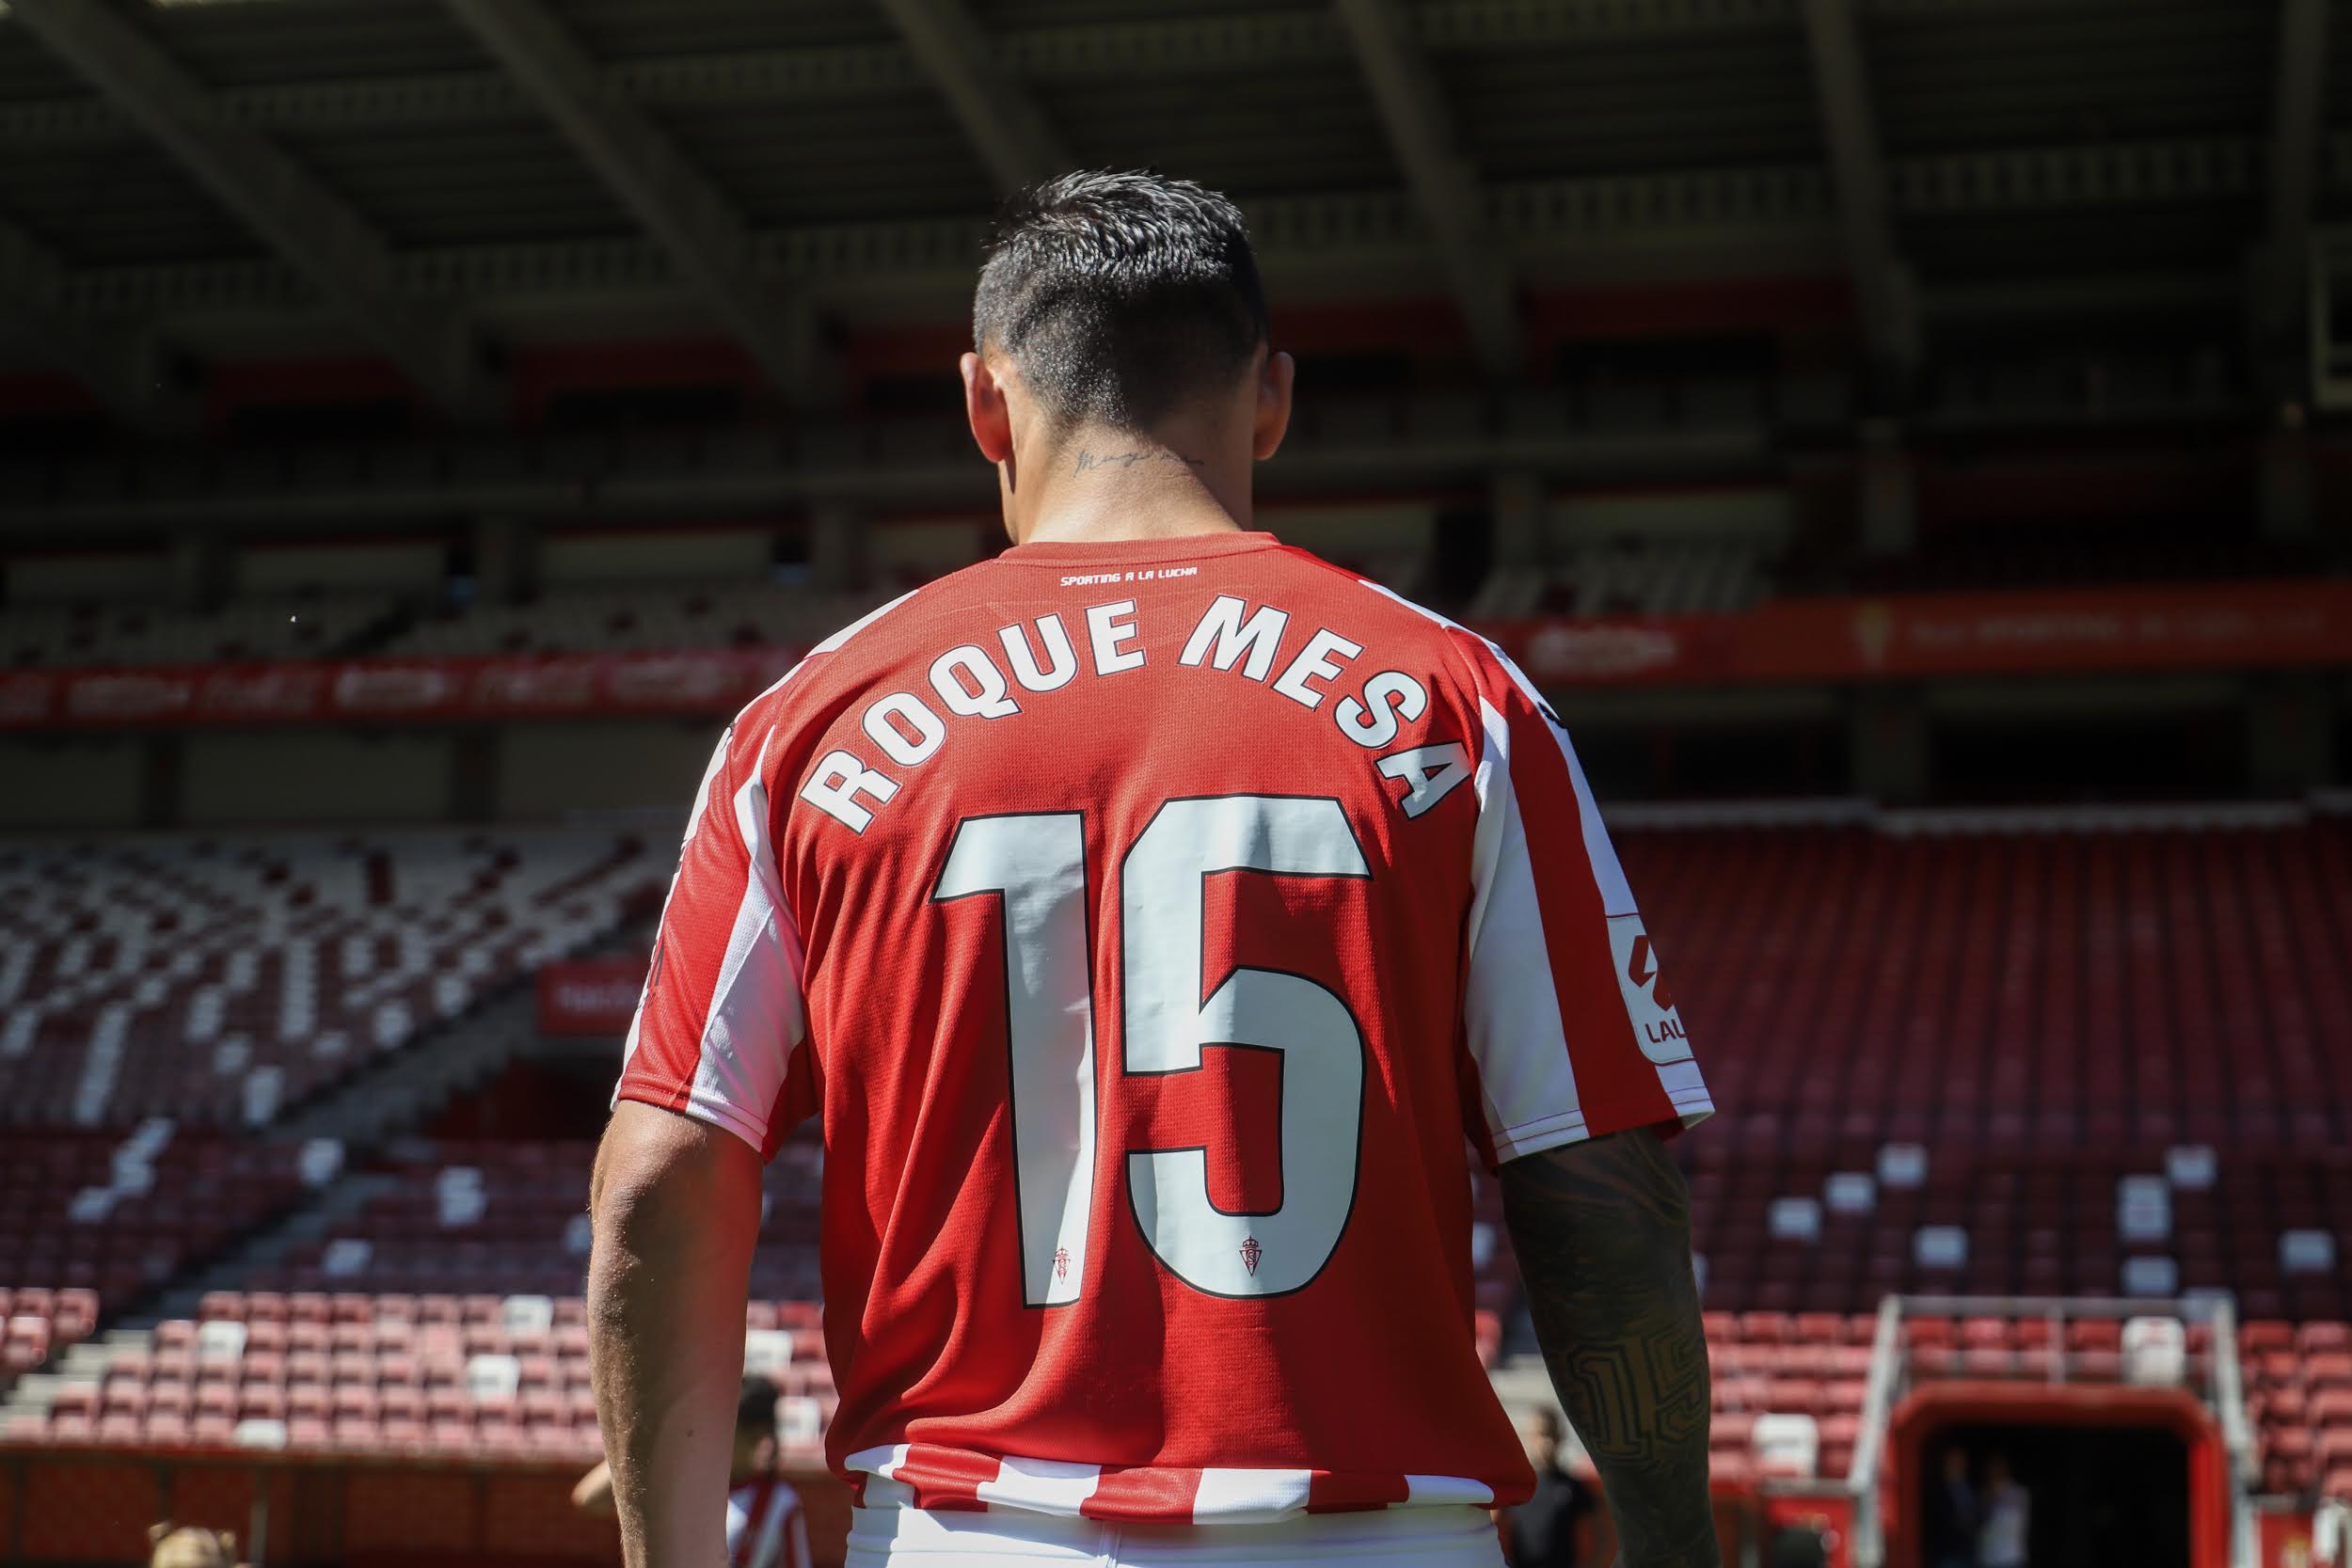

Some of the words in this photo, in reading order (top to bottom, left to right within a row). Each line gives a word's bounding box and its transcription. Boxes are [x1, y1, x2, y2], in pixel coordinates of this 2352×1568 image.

[1060, 573, 1121, 587] SPORTING
[1125, 571, 1135, 581] A
[1138, 570, 1154, 580] LA
[1158, 566, 1198, 578] LUCHA
[798, 598, 1148, 836] ROQUE
[1177, 594, 1472, 819] MESA
[928, 792, 1374, 1309] 15
[1565, 1336, 1709, 1460] 15
